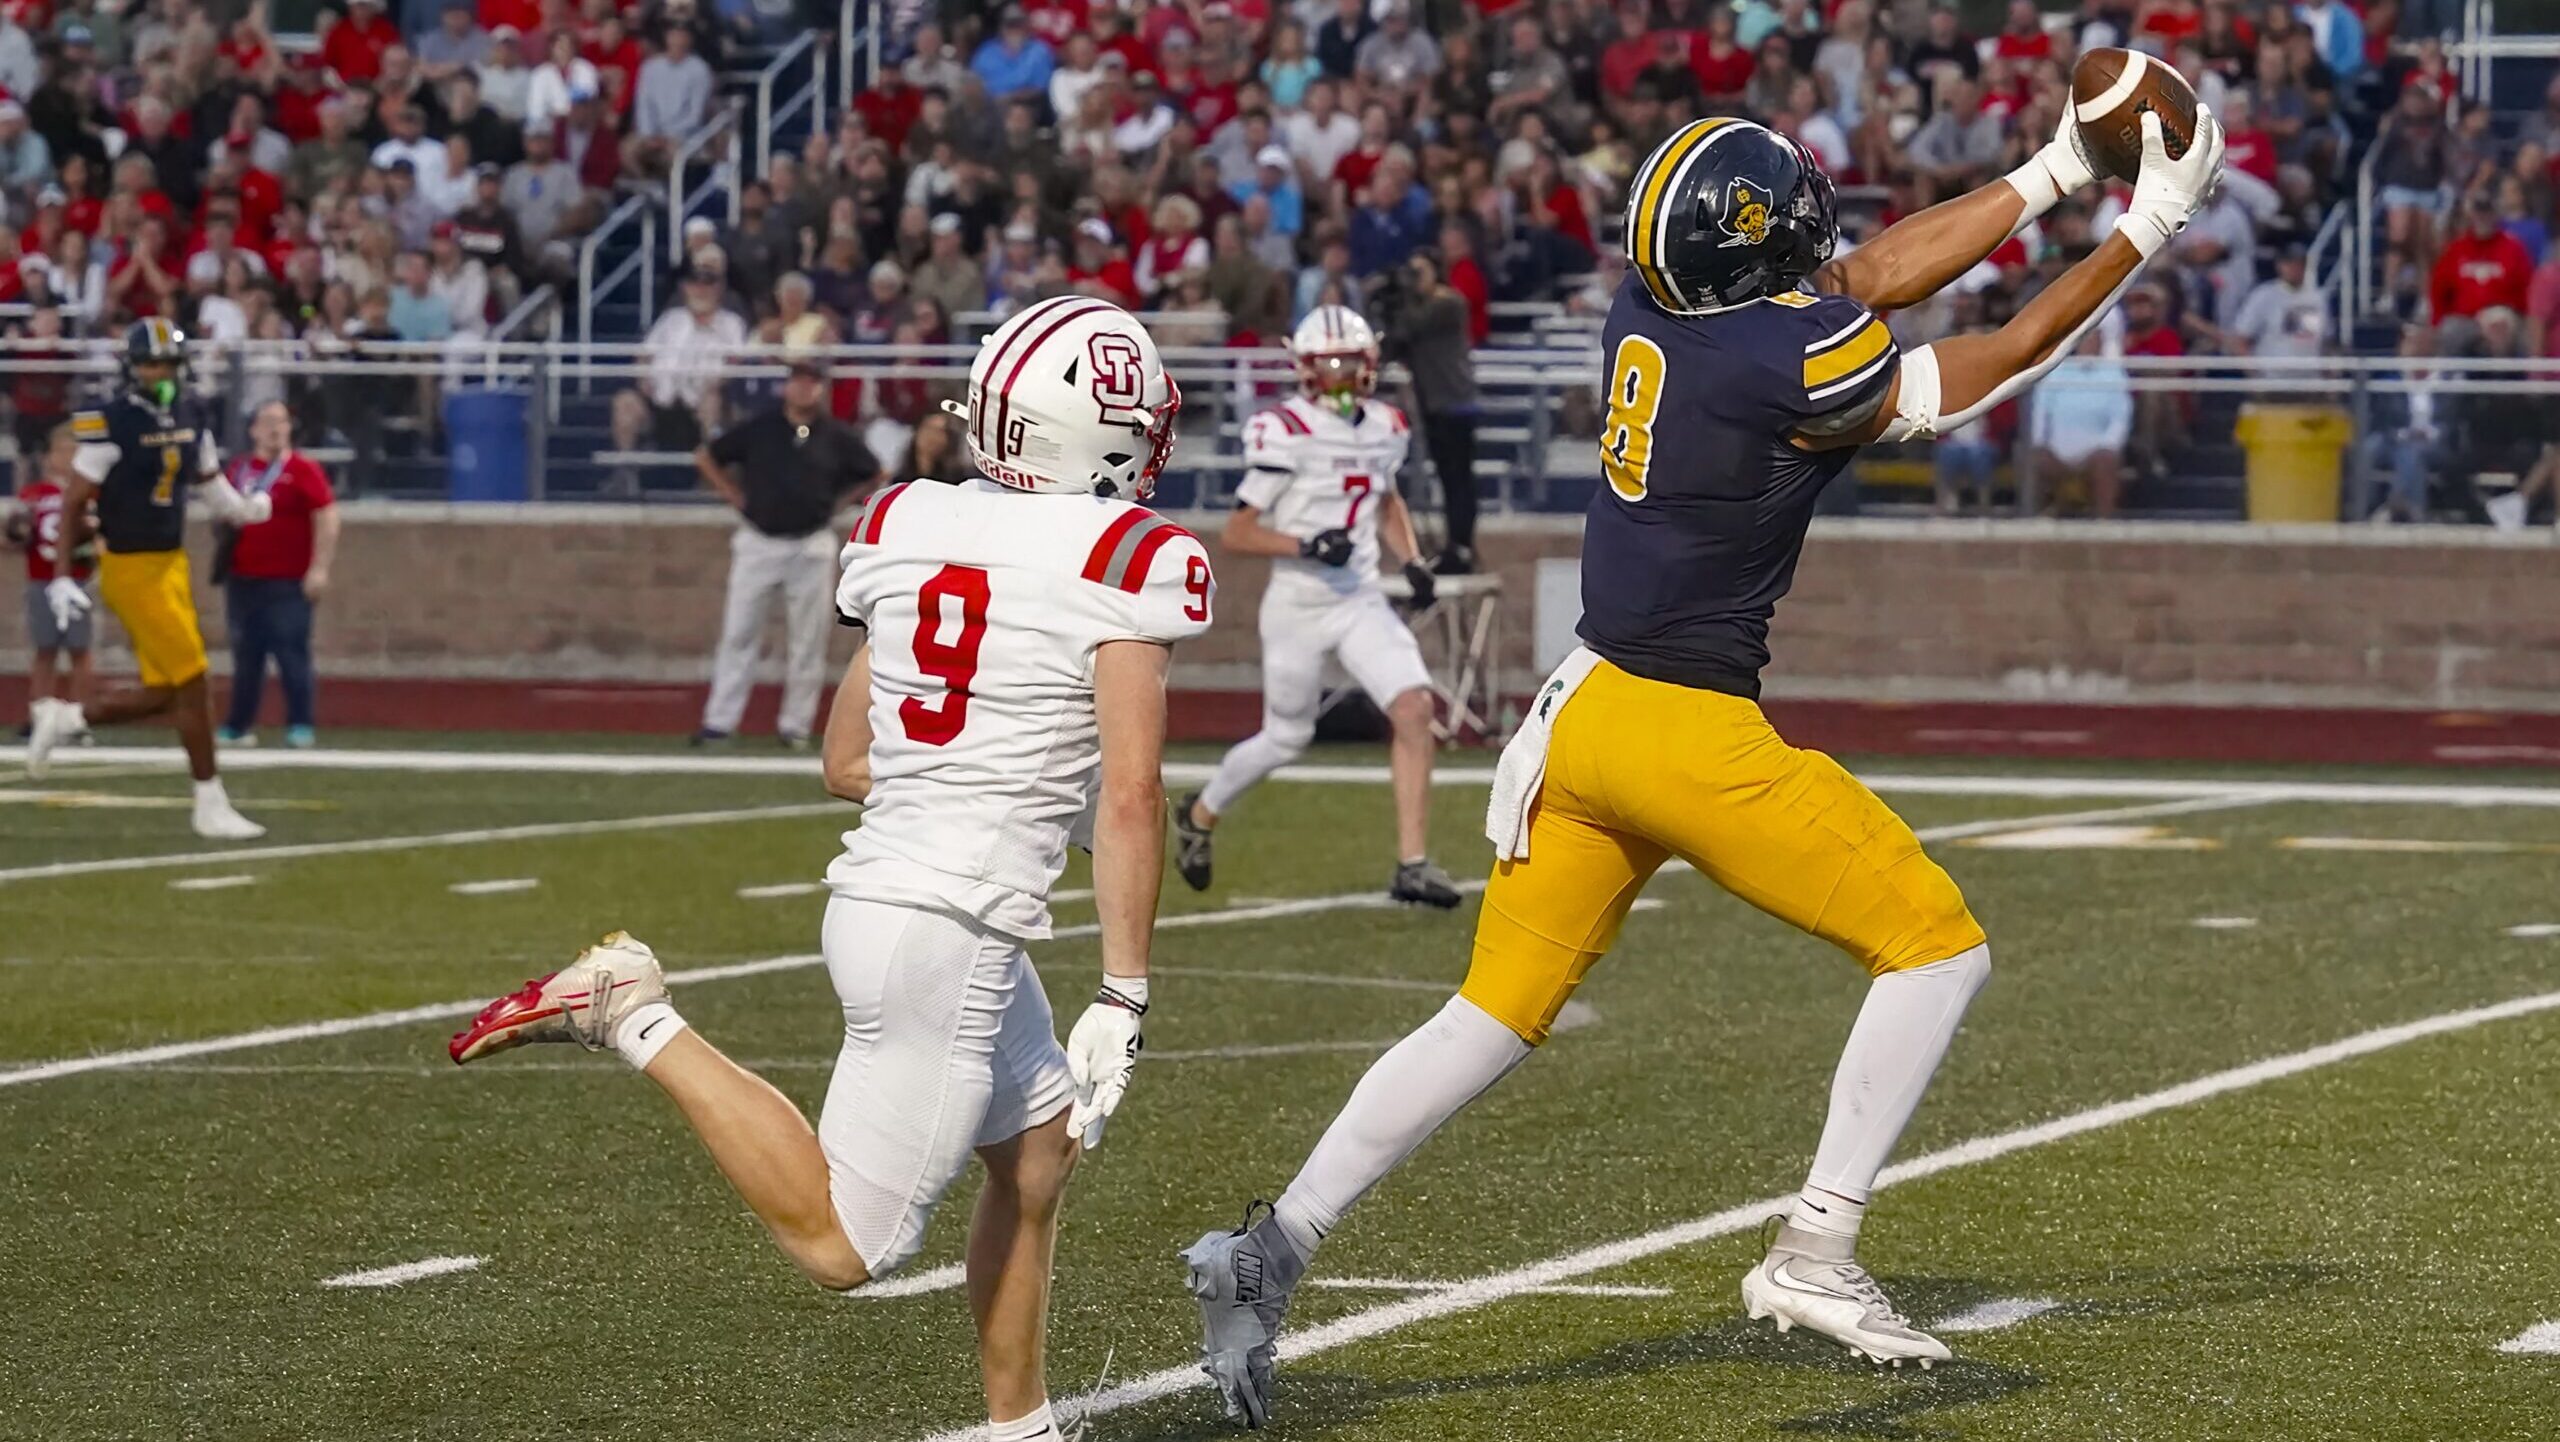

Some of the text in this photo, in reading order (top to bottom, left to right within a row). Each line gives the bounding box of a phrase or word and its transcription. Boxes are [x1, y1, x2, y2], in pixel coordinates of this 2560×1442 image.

[1007, 420, 1025, 457] 9
[1600, 334, 1667, 503] 8
[1344, 476, 1371, 528] 7
[1183, 555, 1210, 622] 9
[899, 563, 991, 746] 9
